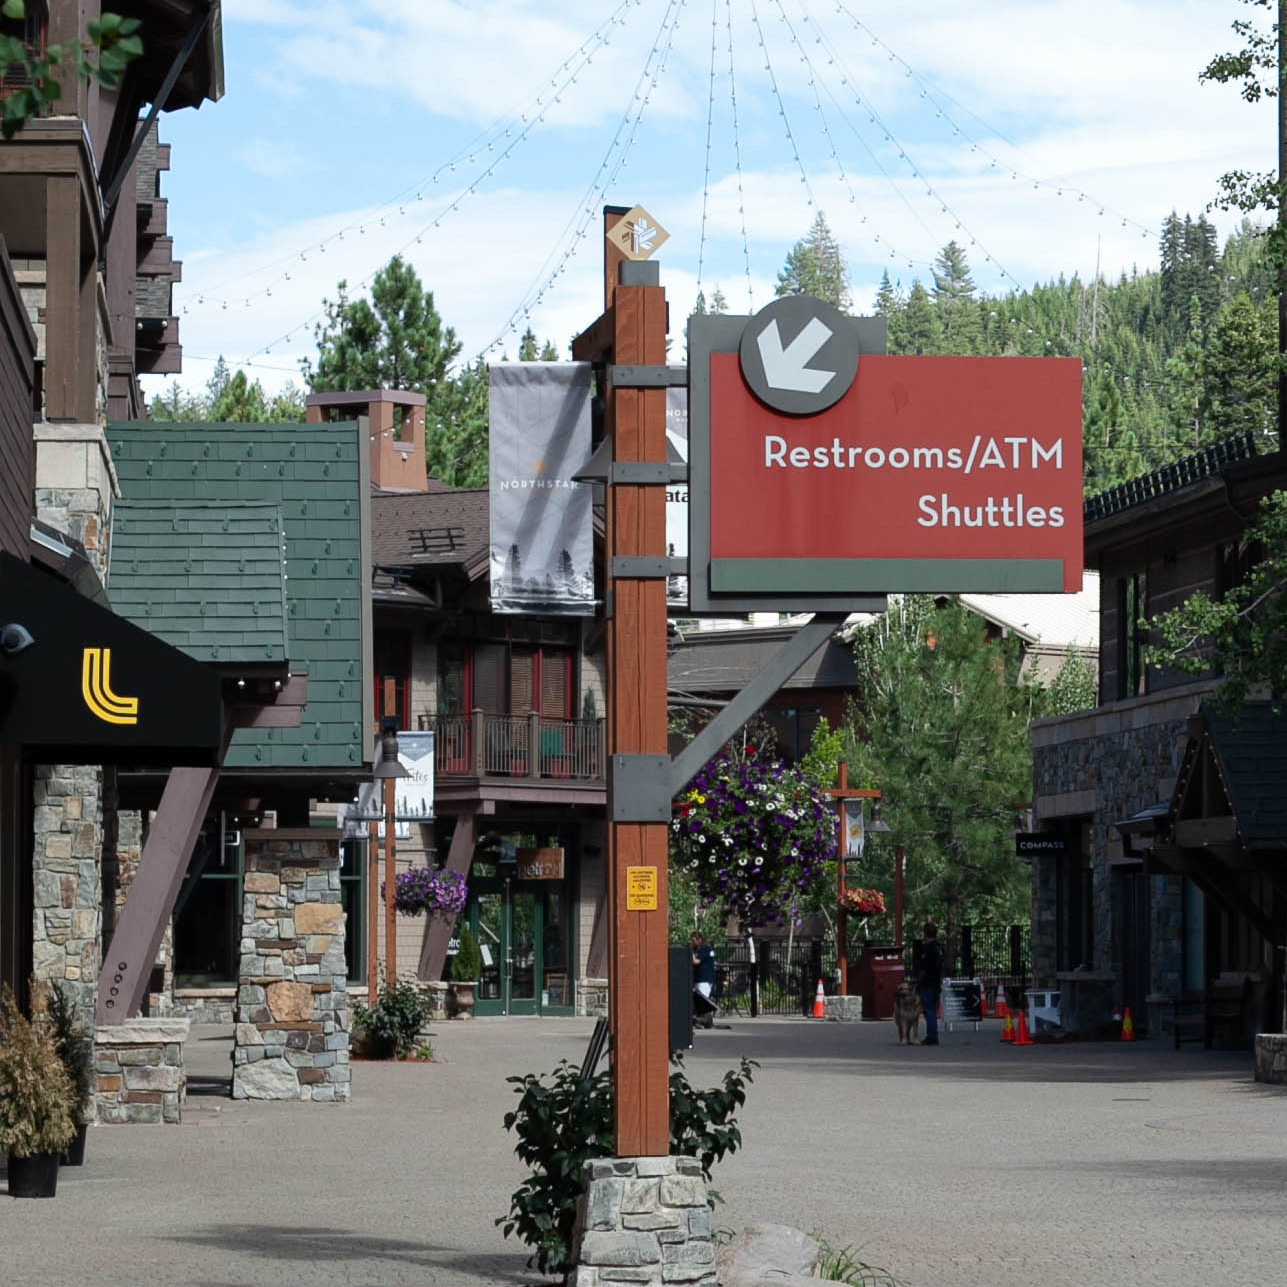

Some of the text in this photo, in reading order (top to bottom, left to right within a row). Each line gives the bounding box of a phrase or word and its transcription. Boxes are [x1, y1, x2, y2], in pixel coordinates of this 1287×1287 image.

[764, 435, 1063, 474] Restrooms/ATM
[500, 480, 579, 490] NORTHSTAR
[917, 493, 1066, 528] Shuttles
[1020, 840, 1065, 850] COMPASS
